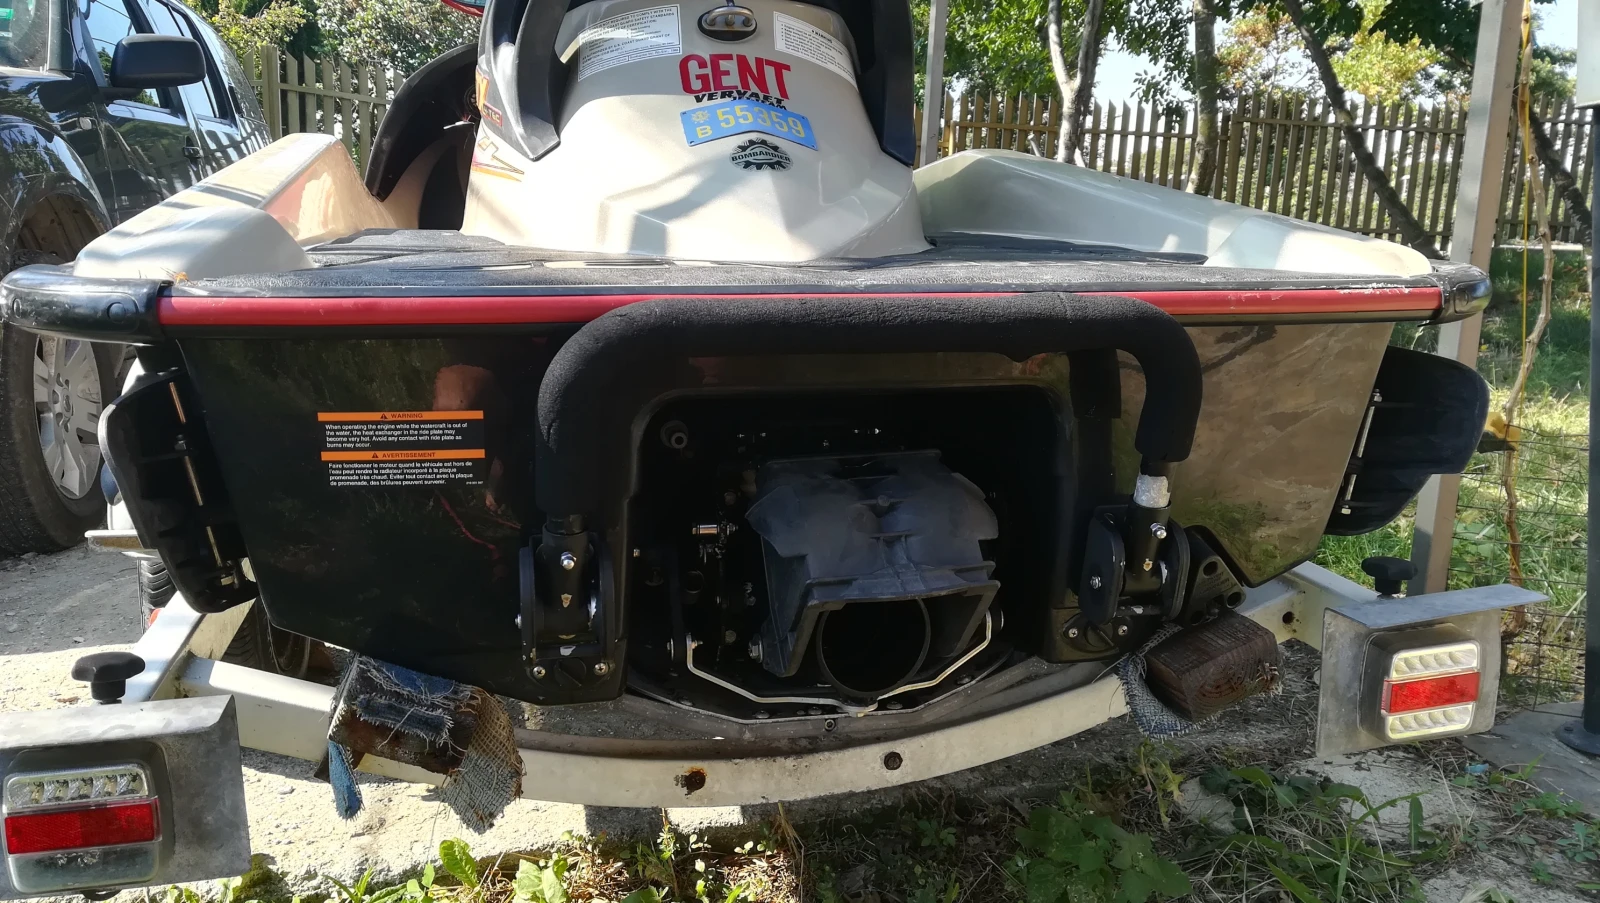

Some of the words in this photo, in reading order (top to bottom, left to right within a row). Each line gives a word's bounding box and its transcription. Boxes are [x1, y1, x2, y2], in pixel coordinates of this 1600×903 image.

[679, 53, 791, 100] GENT
[694, 90, 784, 105] VERVAET
[717, 105, 805, 138] 55359
[696, 125, 712, 138] B
[731, 150, 791, 162] BOMBARDIER
